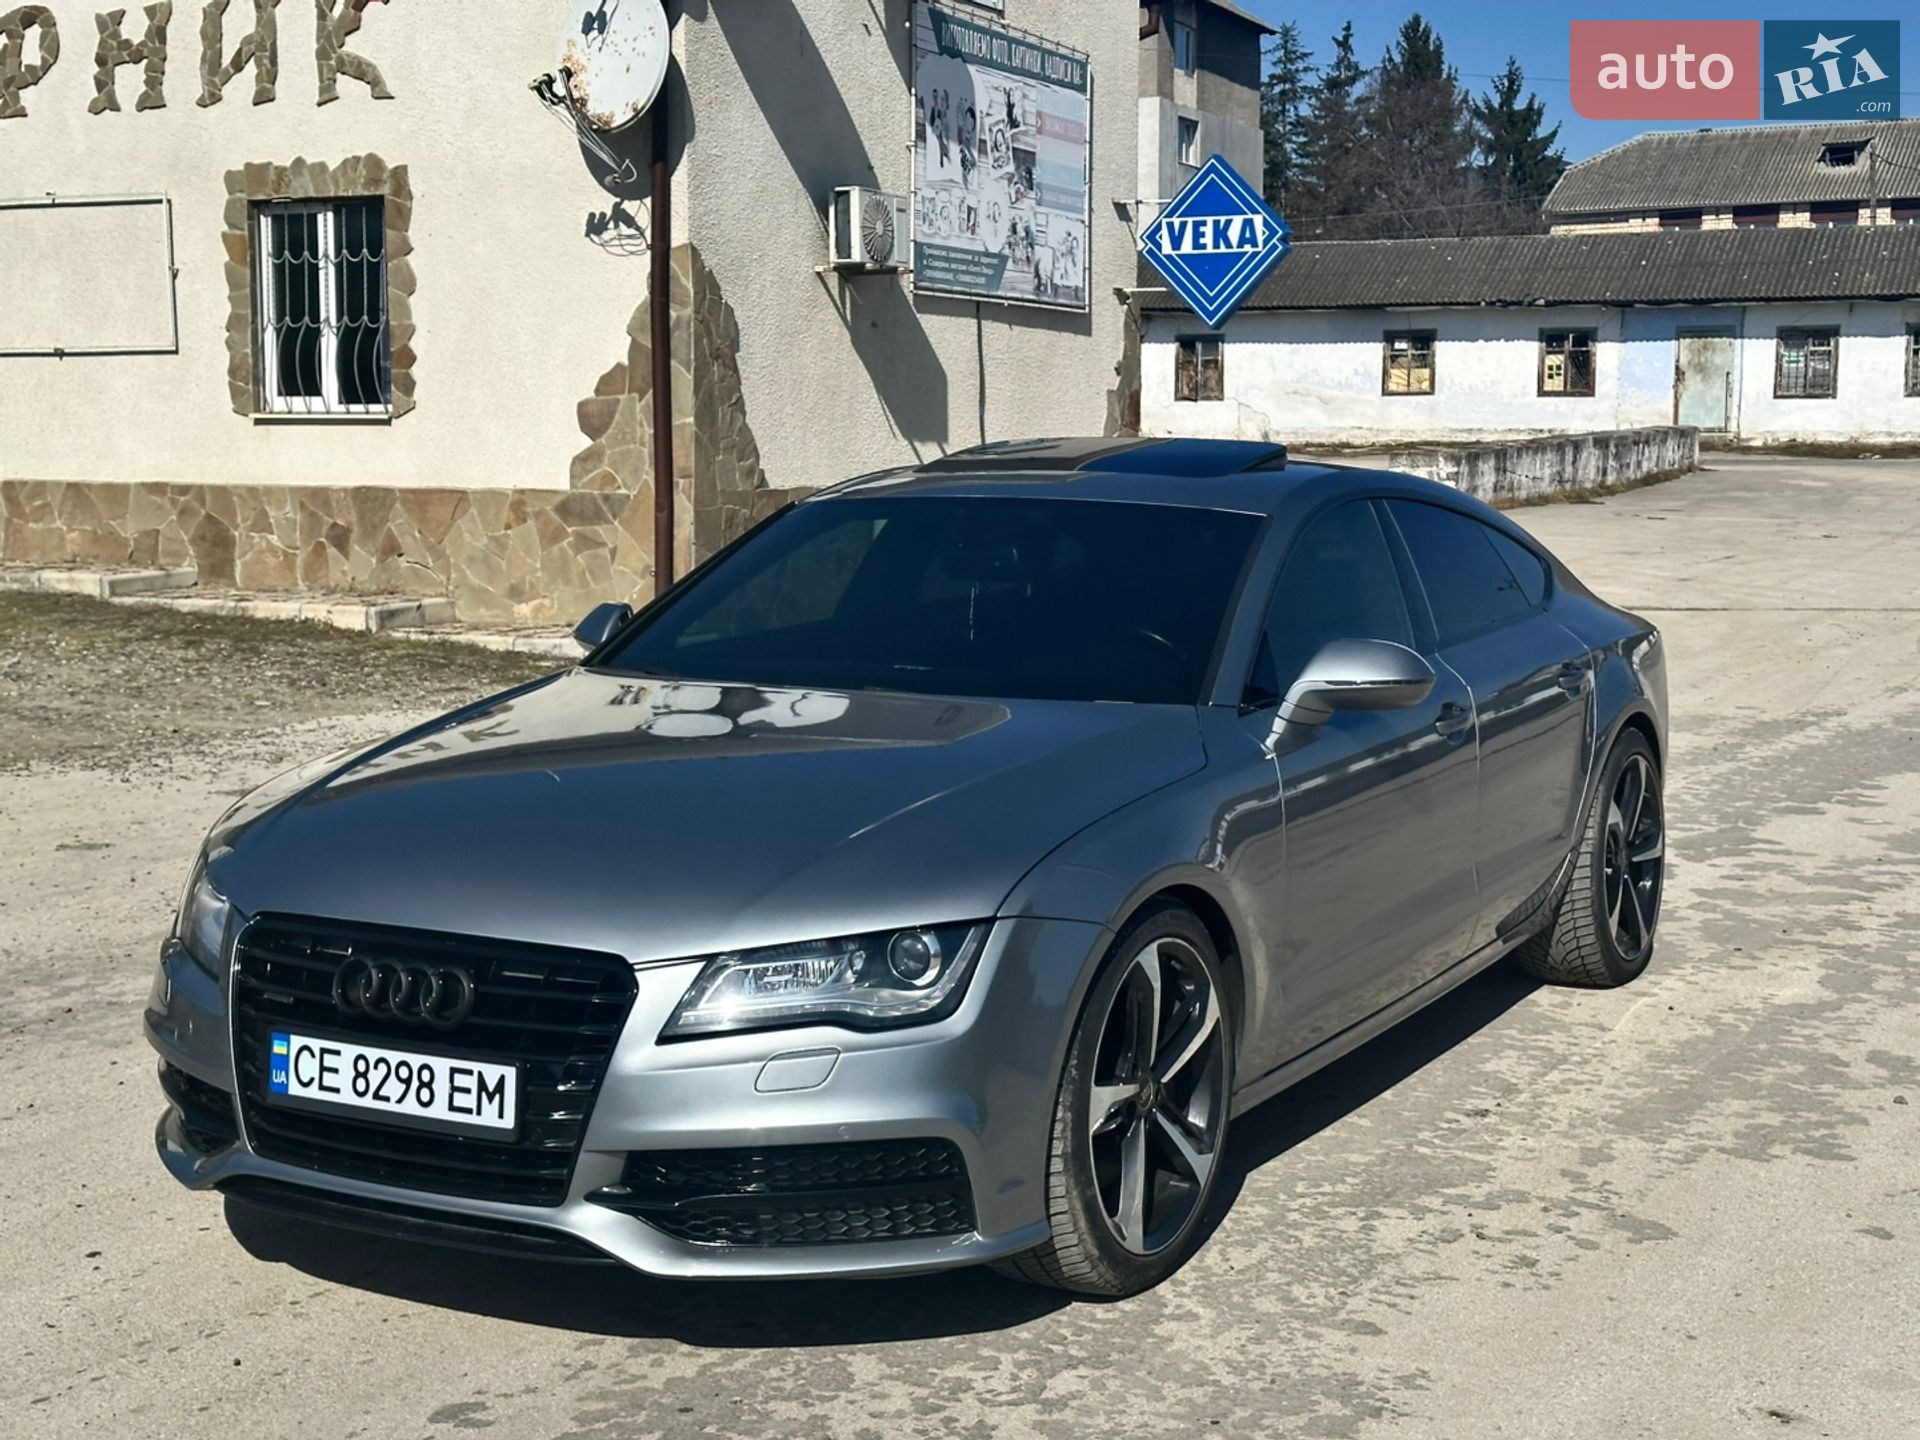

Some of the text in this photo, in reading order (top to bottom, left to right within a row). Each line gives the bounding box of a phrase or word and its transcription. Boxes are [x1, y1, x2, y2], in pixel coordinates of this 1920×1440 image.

[1165, 217, 1260, 252] VEKA
[272, 1069, 288, 1086] UA
[293, 1044, 506, 1120] CE 8298 EM
